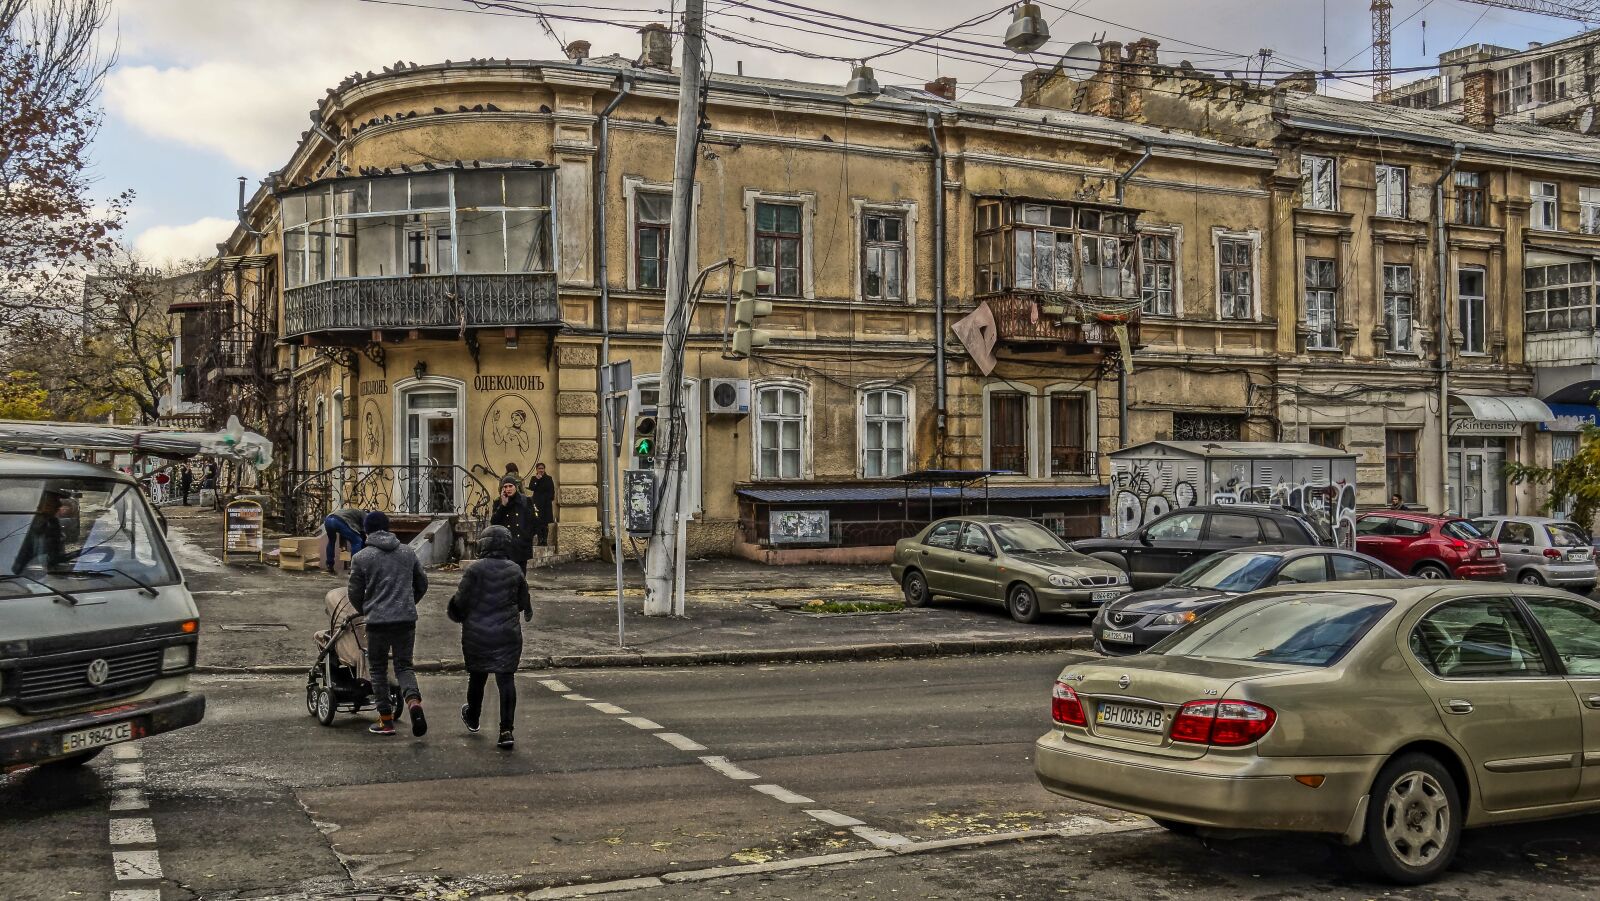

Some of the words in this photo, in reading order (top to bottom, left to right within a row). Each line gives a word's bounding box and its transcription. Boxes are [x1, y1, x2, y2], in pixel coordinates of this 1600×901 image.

[474, 375, 545, 393] ОДЕКОЛОНЪ
[1456, 422, 1518, 432] skintensity
[1104, 706, 1119, 722] BH
[1120, 708, 1144, 725] 0035
[1145, 711, 1162, 727] AB
[70, 733, 87, 749] BH
[88, 728, 113, 744] 9842
[115, 724, 130, 739] CE
